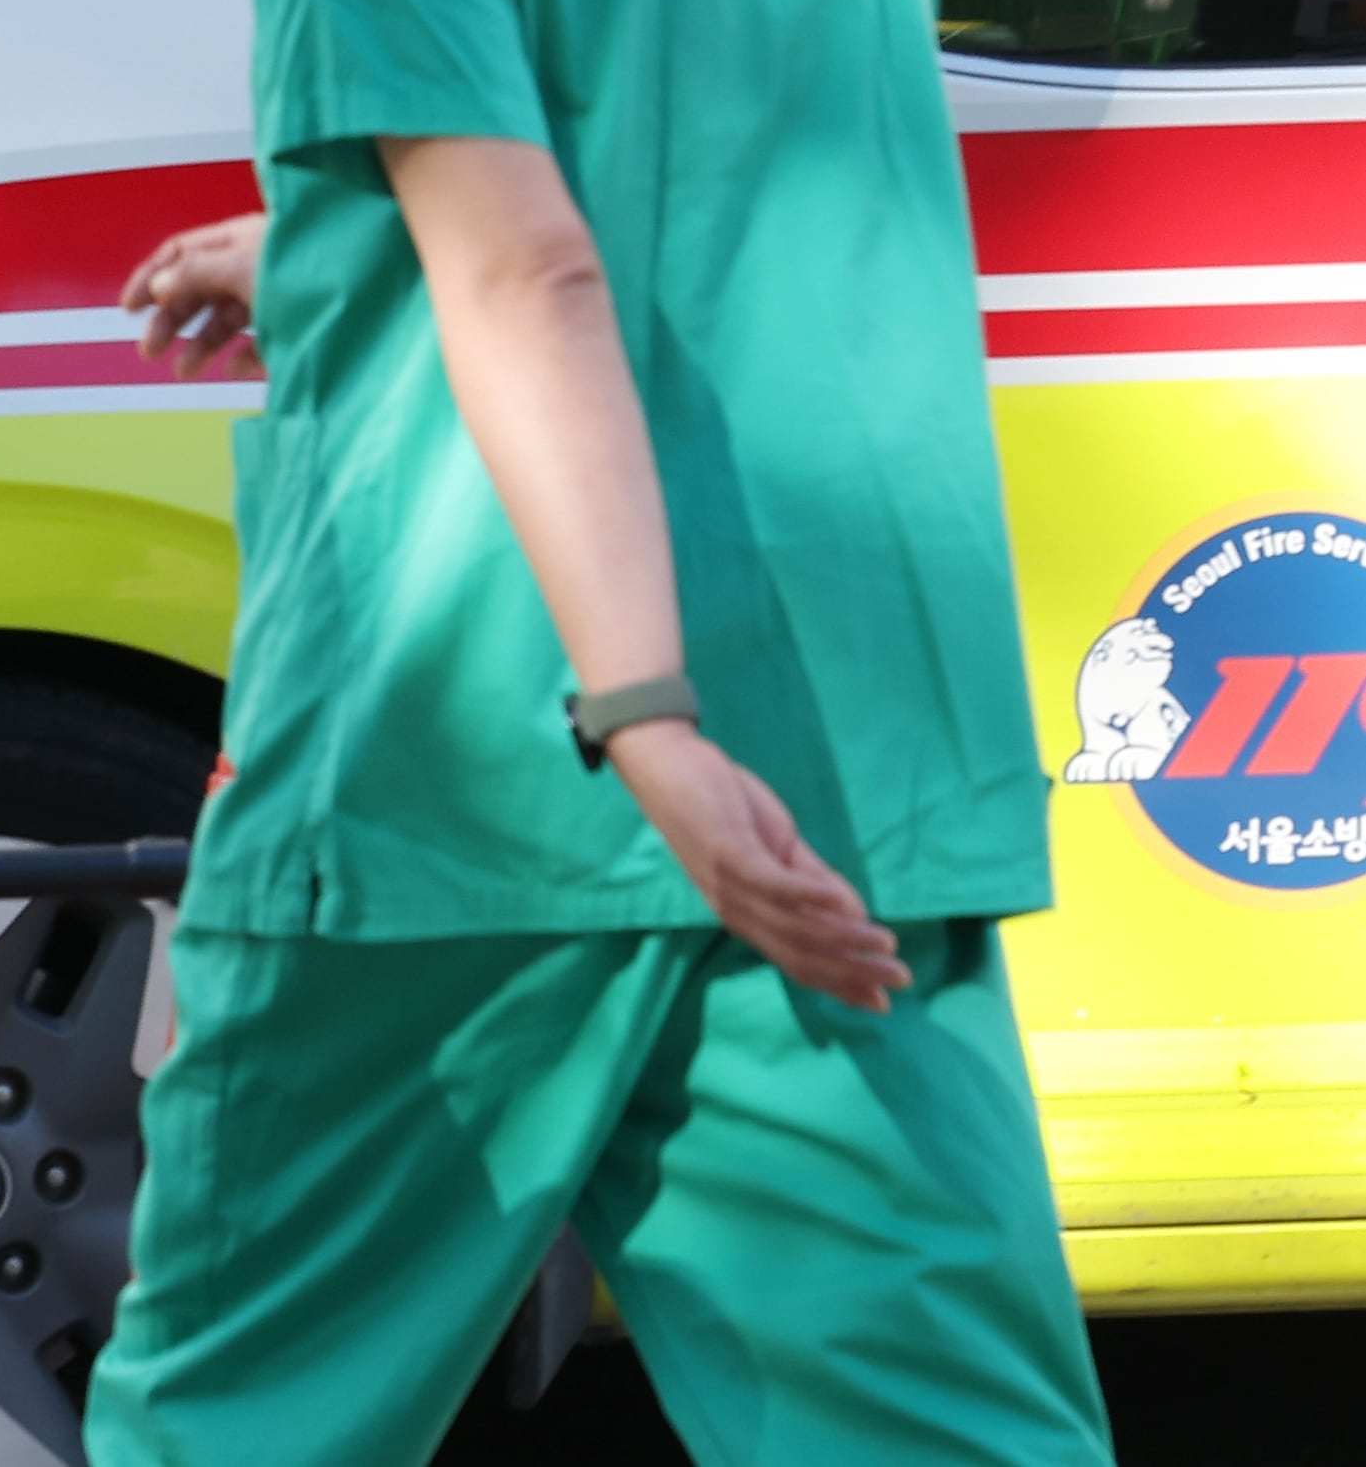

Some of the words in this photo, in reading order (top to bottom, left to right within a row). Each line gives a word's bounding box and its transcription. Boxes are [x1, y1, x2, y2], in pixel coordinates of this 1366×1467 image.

[1161, 539, 1243, 614] Seoul
[1242, 525, 1306, 564] Fire
[1163, 654, 1366, 778] 11
